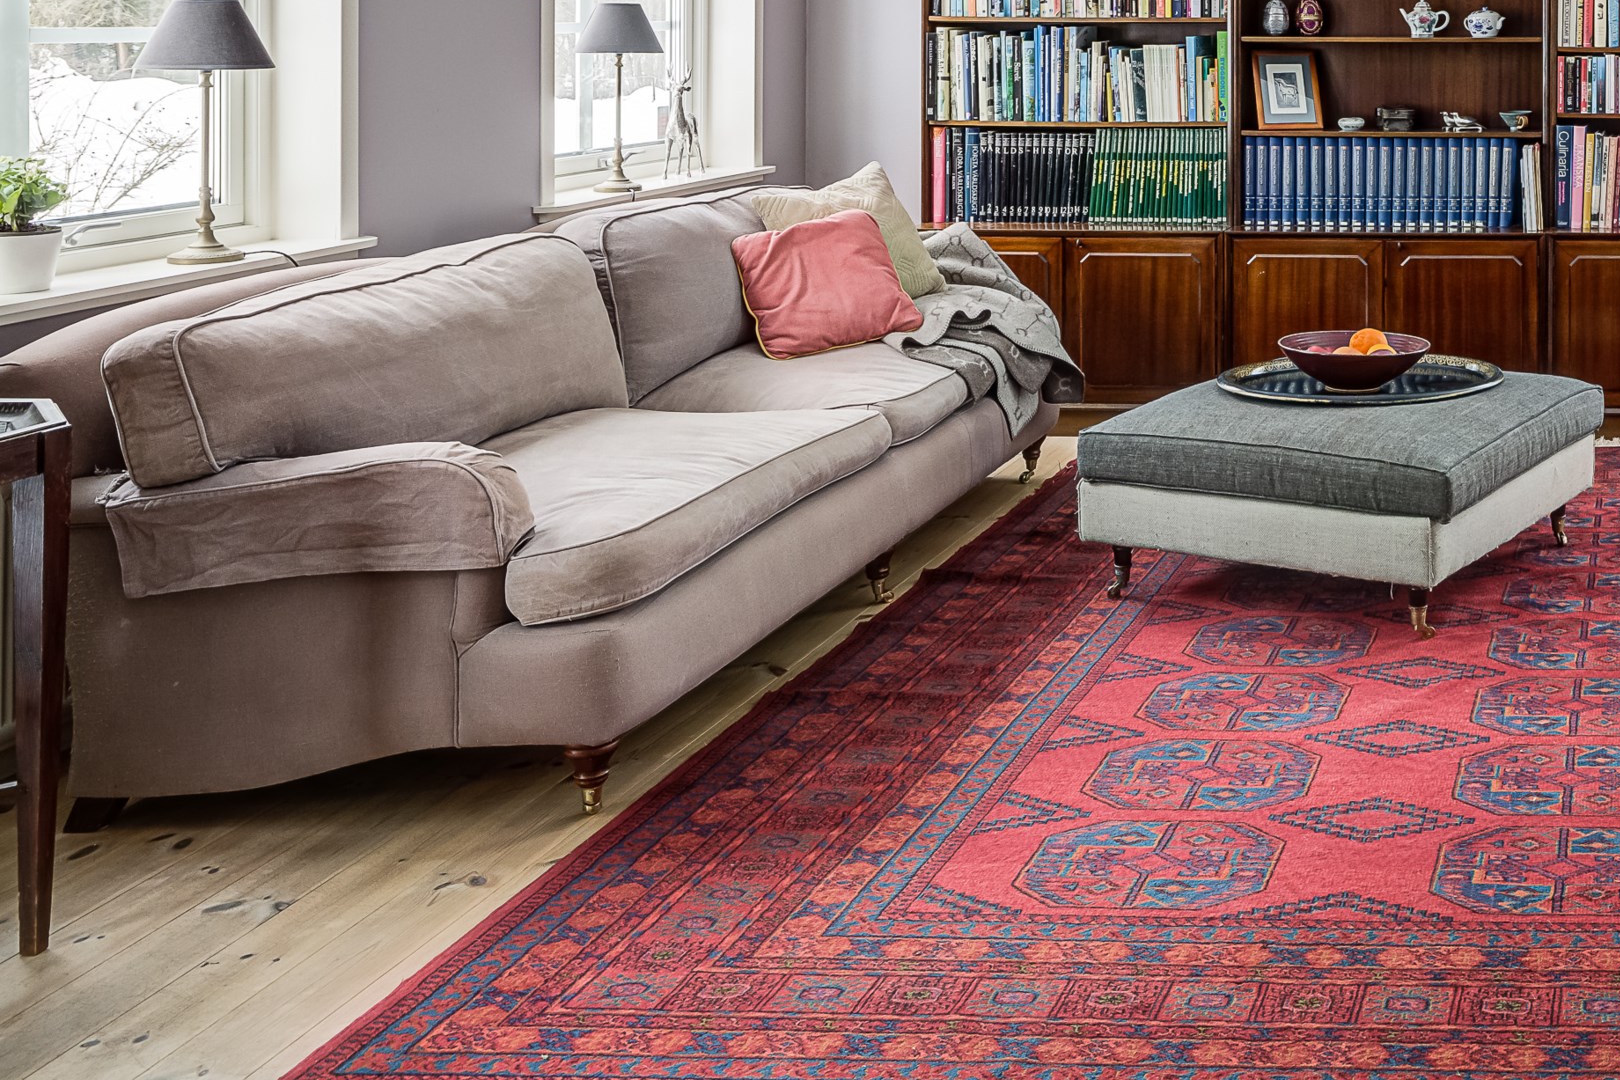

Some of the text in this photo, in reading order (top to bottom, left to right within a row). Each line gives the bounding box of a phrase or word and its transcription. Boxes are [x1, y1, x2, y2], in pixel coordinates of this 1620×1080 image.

[1013, 62, 1021, 82] Sarek
[1558, 130, 1570, 178] Culinaria
[1575, 144, 1583, 189] FRANSKA
[956, 171, 964, 217] VÄRLDSKRIGET
[971, 169, 979, 215] VÄRLDSKRIGET
